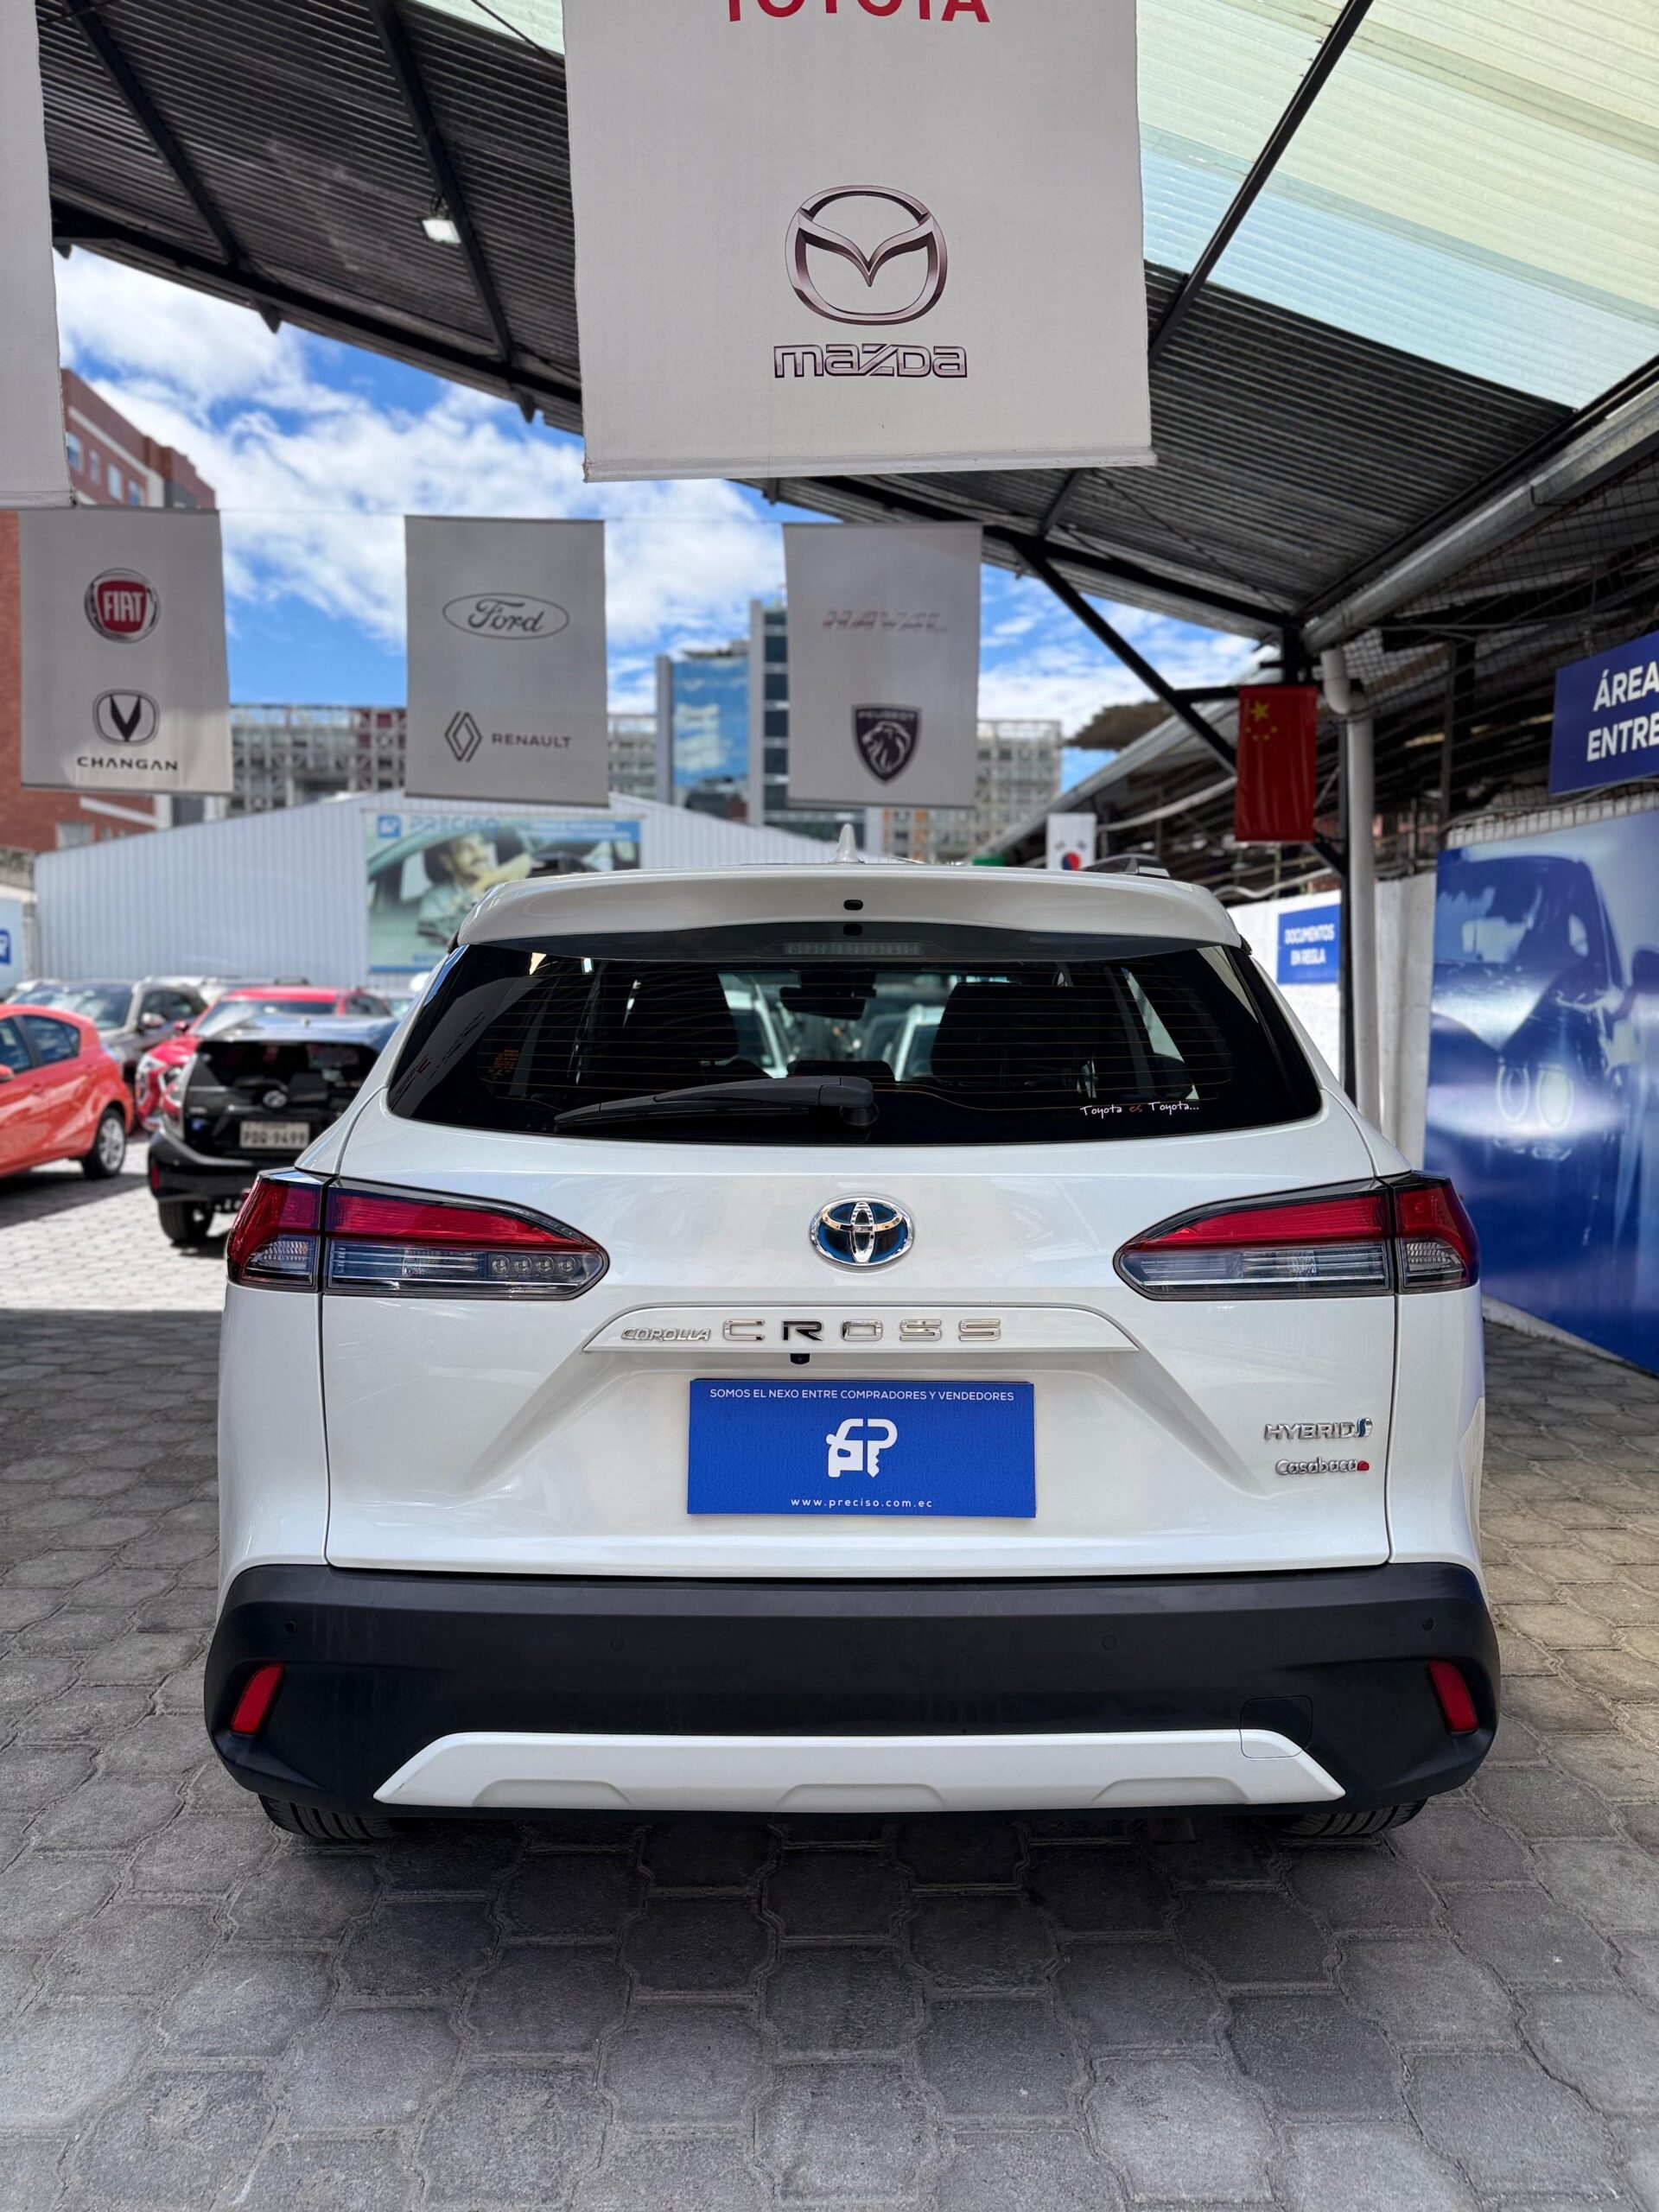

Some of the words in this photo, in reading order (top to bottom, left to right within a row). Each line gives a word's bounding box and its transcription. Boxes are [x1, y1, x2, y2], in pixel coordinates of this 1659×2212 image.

[102, 590, 143, 622] FIAT
[467, 597, 545, 632] Ford
[1592, 660, 1659, 712] ÁREA
[492, 733, 572, 748] RENAULT
[77, 756, 179, 771] CHANGAN
[1080, 1104, 1122, 1119] Toyota
[621, 1327, 711, 1341] COROLLA
[723, 1319, 1001, 1341] CROSS
[709, 1389, 751, 1398] SOMOS
[753, 1389, 766, 1398] EL
[768, 1389, 799, 1399] NEXO
[802, 1389, 838, 1399] ENTRE
[840, 1389, 927, 1400] COMPRADORES
[929, 1391, 937, 1400] Y
[938, 1392, 1014, 1402] VENDEDORES
[1263, 1421, 1357, 1441] HYBRID
[1274, 1455, 1358, 1476] Casabaca
[791, 1497, 932, 1509] www.preciso.com.ec
